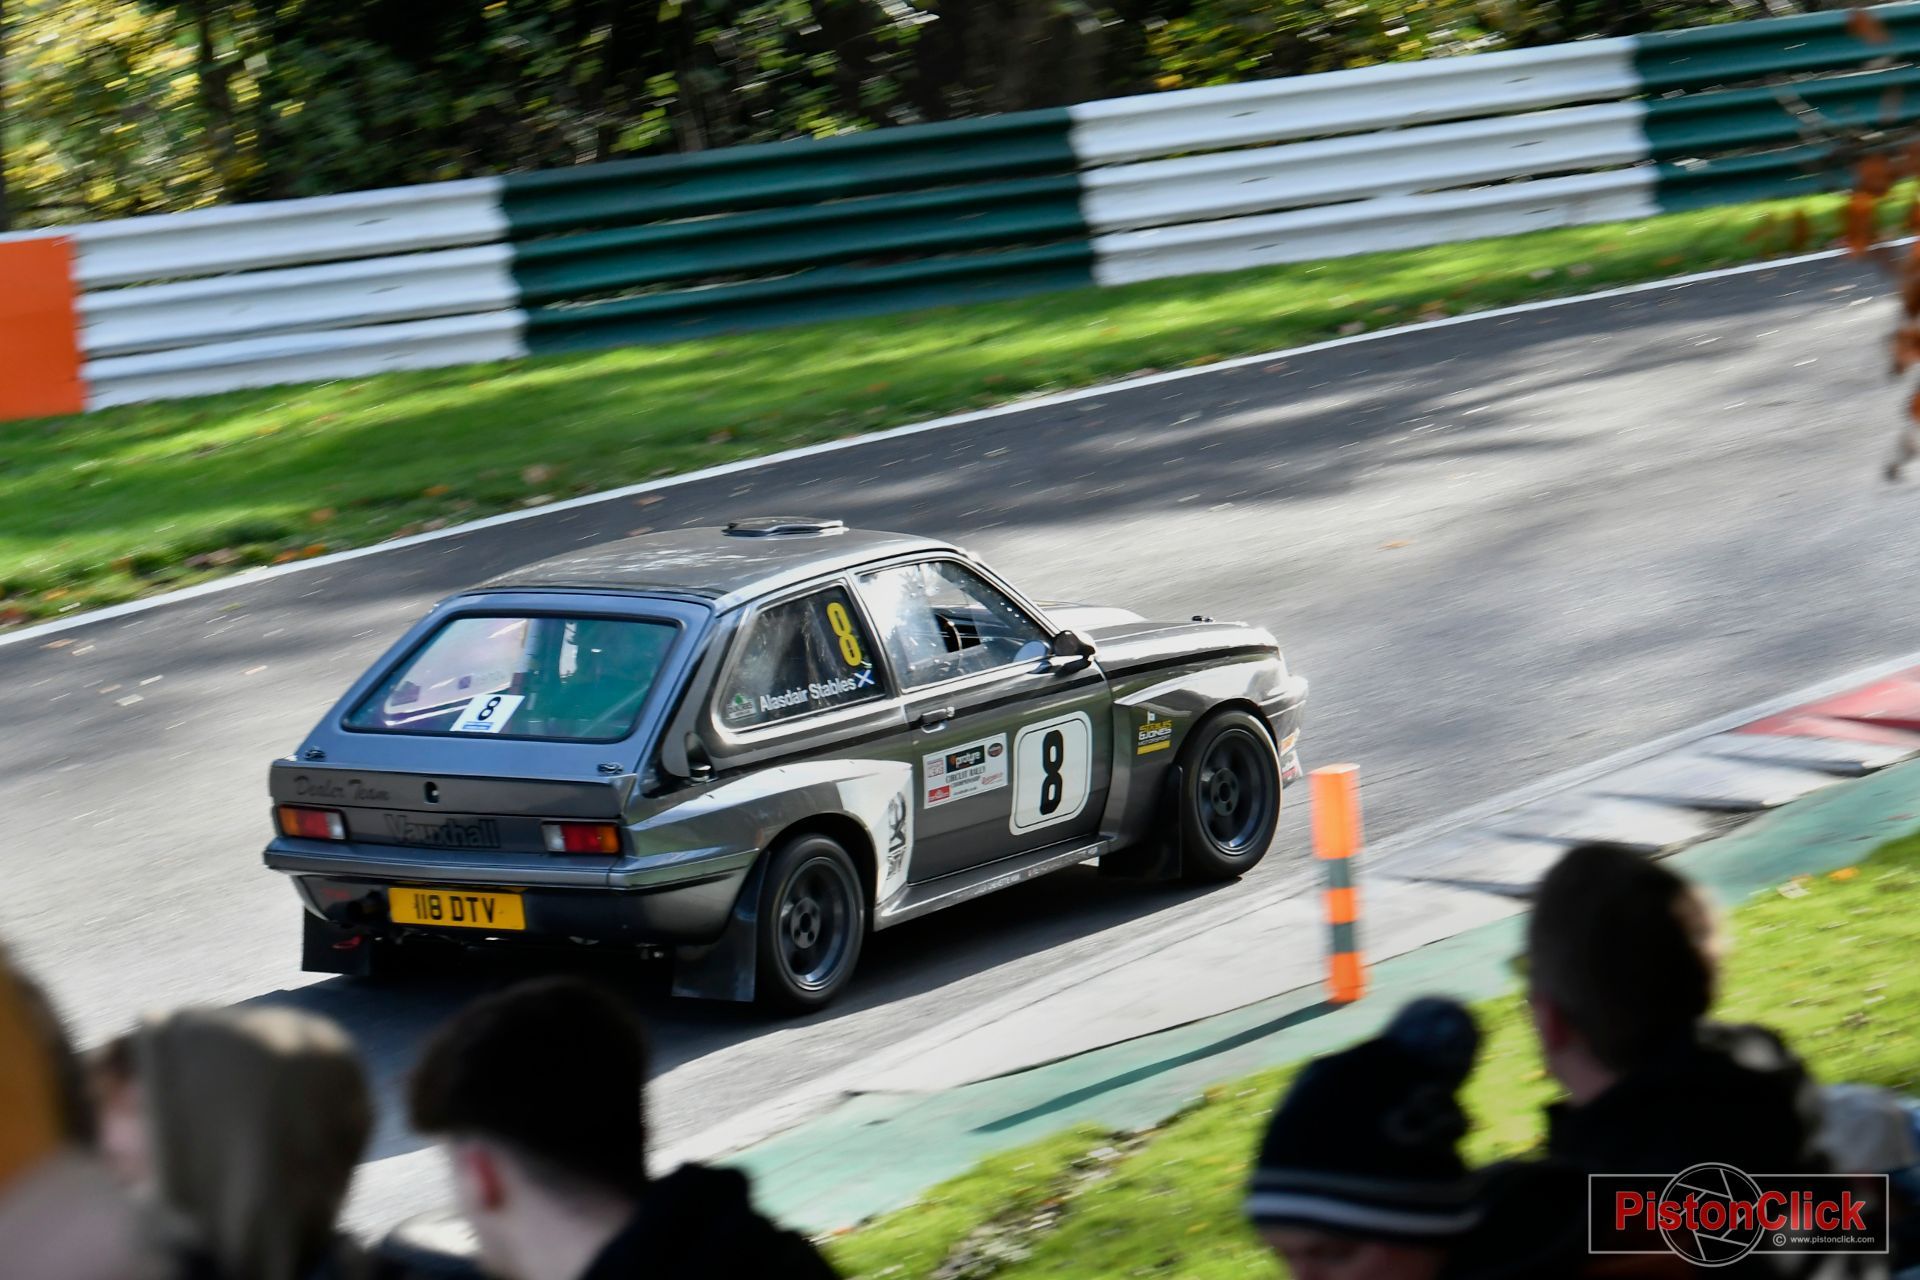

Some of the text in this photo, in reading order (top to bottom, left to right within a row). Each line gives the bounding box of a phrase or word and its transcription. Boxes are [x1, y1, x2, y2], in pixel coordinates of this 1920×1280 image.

[827, 602, 862, 667] 8
[478, 696, 502, 722] 8
[759, 686, 809, 713] Alasdair
[808, 677, 857, 701] Stables
[293, 775, 390, 802] Dealer Team
[1039, 729, 1064, 816] 8
[383, 813, 501, 849] Vauxhall
[413, 893, 496, 924] 118 DTV
